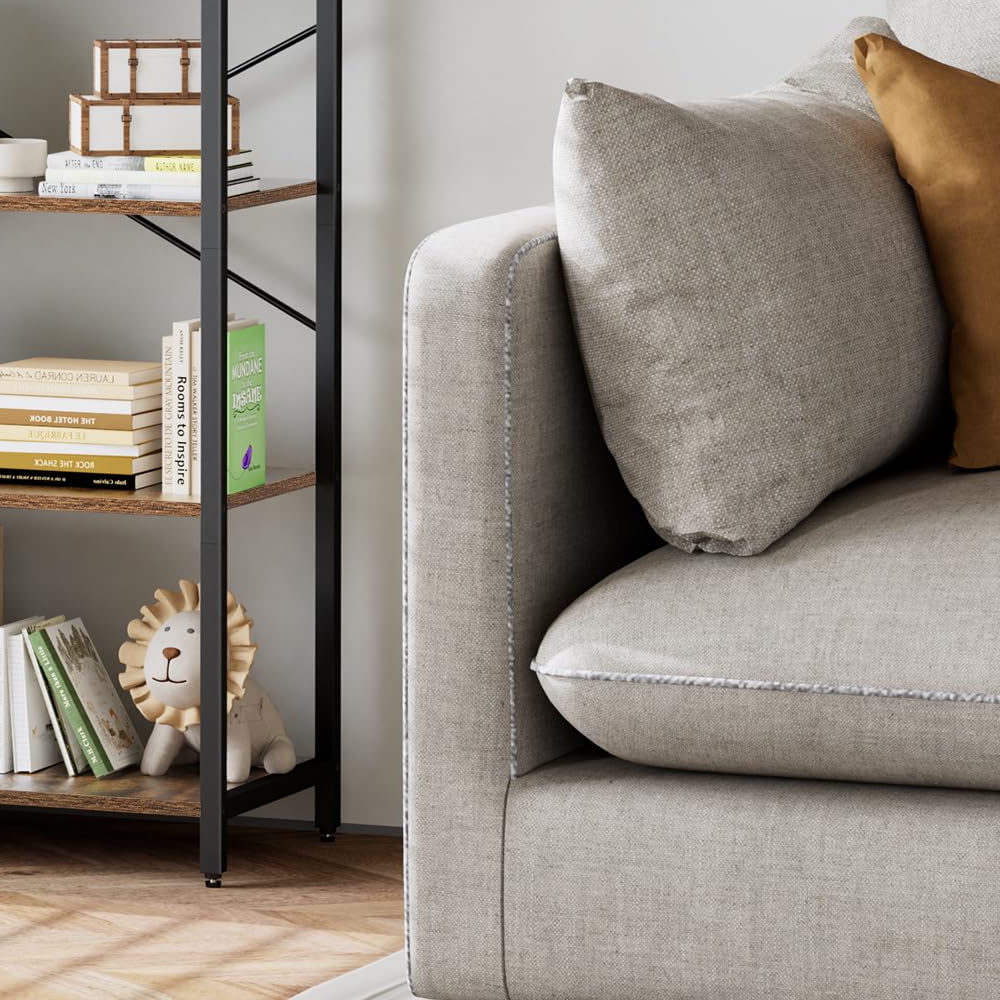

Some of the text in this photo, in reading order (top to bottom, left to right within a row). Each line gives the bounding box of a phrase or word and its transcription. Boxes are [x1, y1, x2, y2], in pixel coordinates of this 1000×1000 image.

[92, 159, 103, 169] END
[155, 161, 195, 172] AUTHOR NAME
[41, 183, 77, 194] New York
[165, 346, 173, 396] MOUNTAIN
[232, 357, 262, 380] MUNDANE
[165, 398, 173, 420] GRAY
[165, 424, 173, 435] DE
[174, 376, 188, 485] Rooms to Inspire
[165, 437, 173, 473] SECRETO
[37, 646, 50, 666] Little
[50, 672, 63, 689] than
[59, 689, 72, 708] More
